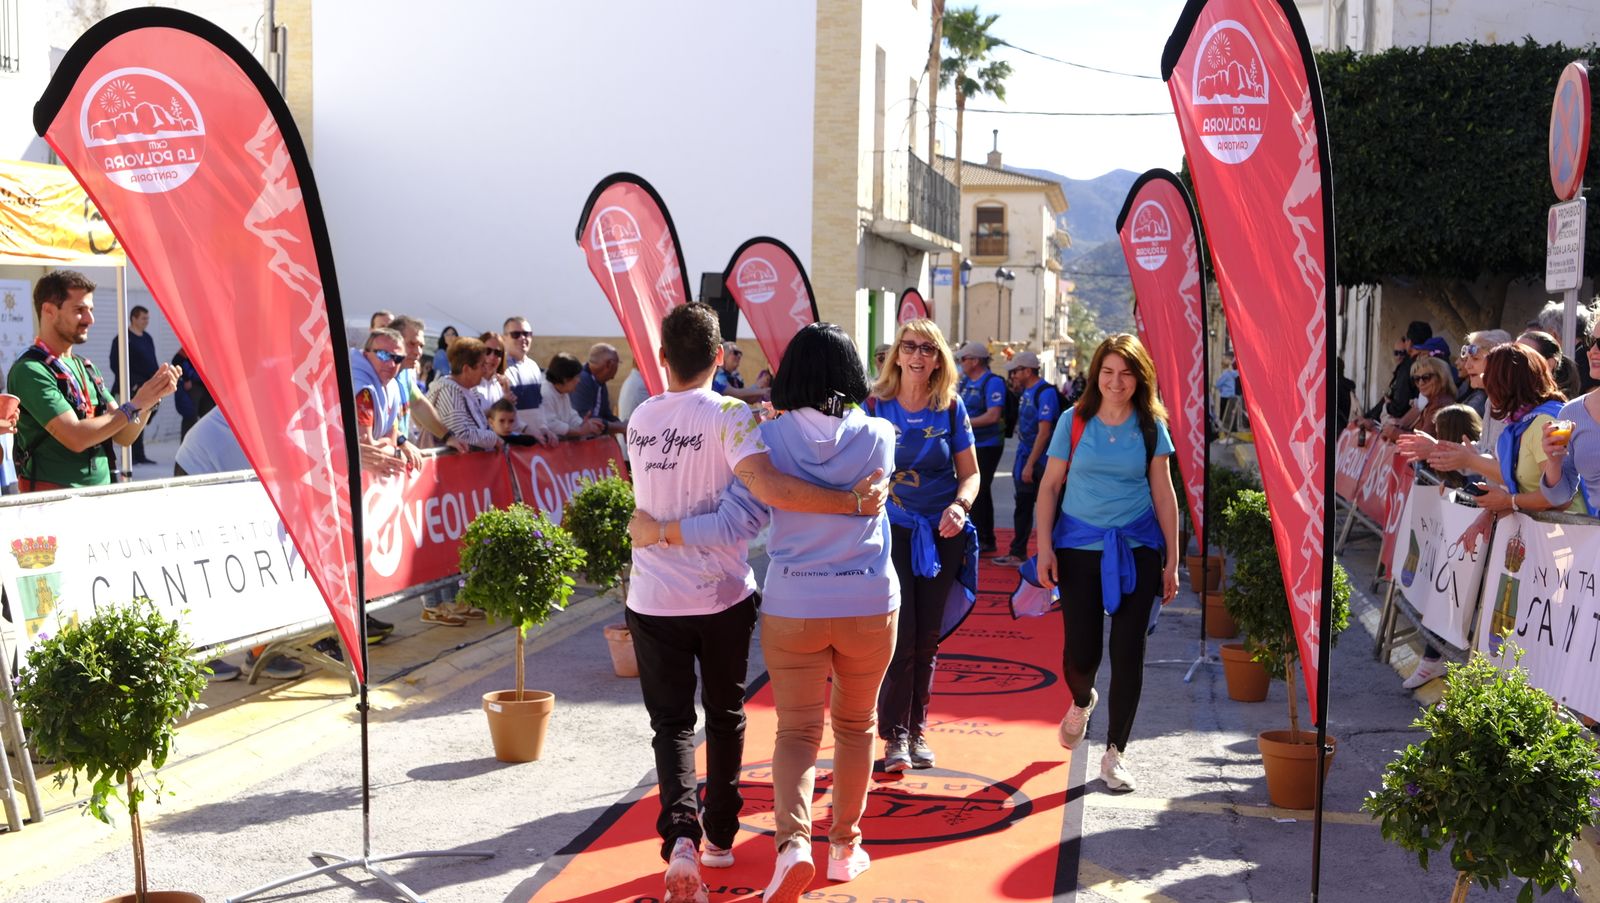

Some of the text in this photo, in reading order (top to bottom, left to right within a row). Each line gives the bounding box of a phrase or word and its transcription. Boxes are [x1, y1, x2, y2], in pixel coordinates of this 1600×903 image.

[628, 427, 704, 457] Pepe Yepes
[644, 457, 678, 474] speaker
[88, 519, 273, 566] AYUNTAMENTO
[92, 544, 308, 617] CANTORI
